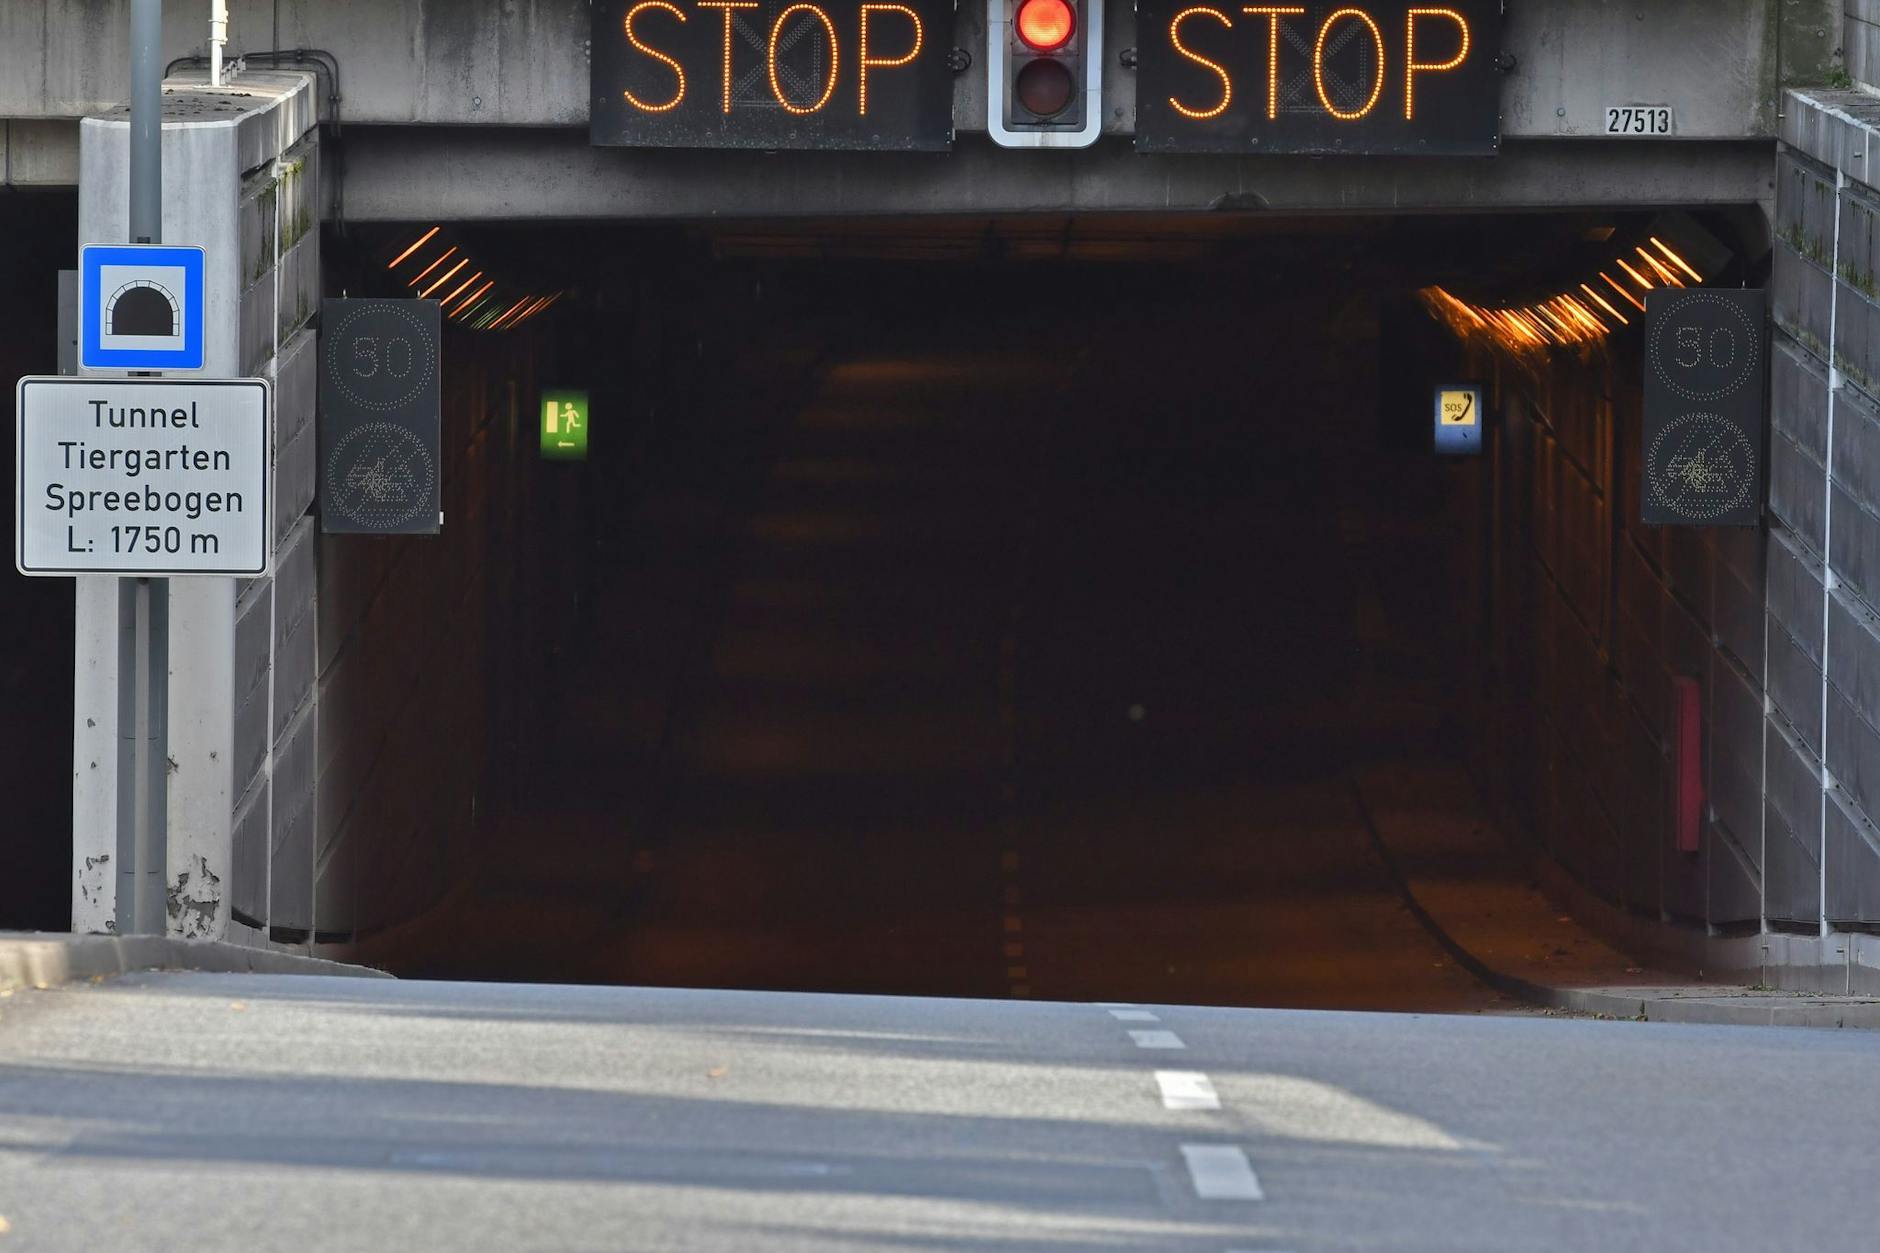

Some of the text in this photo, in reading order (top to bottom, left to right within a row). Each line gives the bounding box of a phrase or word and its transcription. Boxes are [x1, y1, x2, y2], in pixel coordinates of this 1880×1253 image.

[622, 0, 924, 116] STOP
[1168, 5, 1471, 120] STOP
[1608, 108, 1669, 133] 27513
[88, 400, 199, 428] Tunnel
[1444, 402, 1463, 413] SOS
[57, 441, 231, 477] Tiergarten
[44, 483, 243, 519] Spreebogen
[67, 525, 219, 554] L: 1750 m
